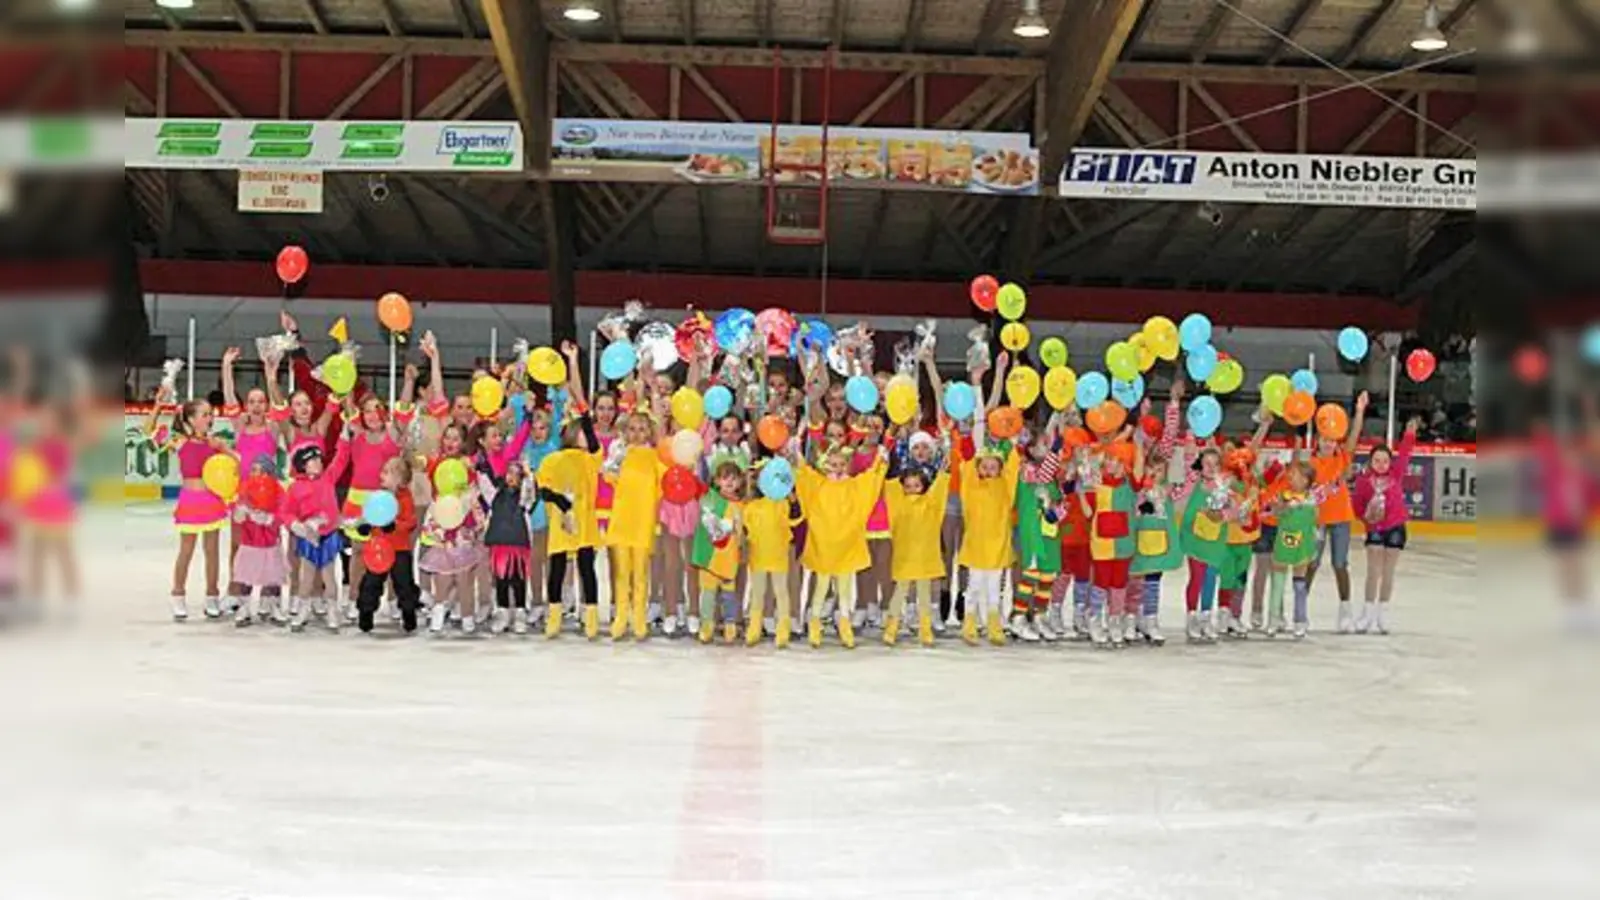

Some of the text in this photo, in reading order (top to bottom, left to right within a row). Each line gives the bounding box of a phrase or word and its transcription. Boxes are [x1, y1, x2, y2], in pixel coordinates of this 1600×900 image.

[1068, 153, 1195, 184] FIAT
[1208, 156, 1299, 179] Anton
[1311, 159, 1423, 183] Niebler
